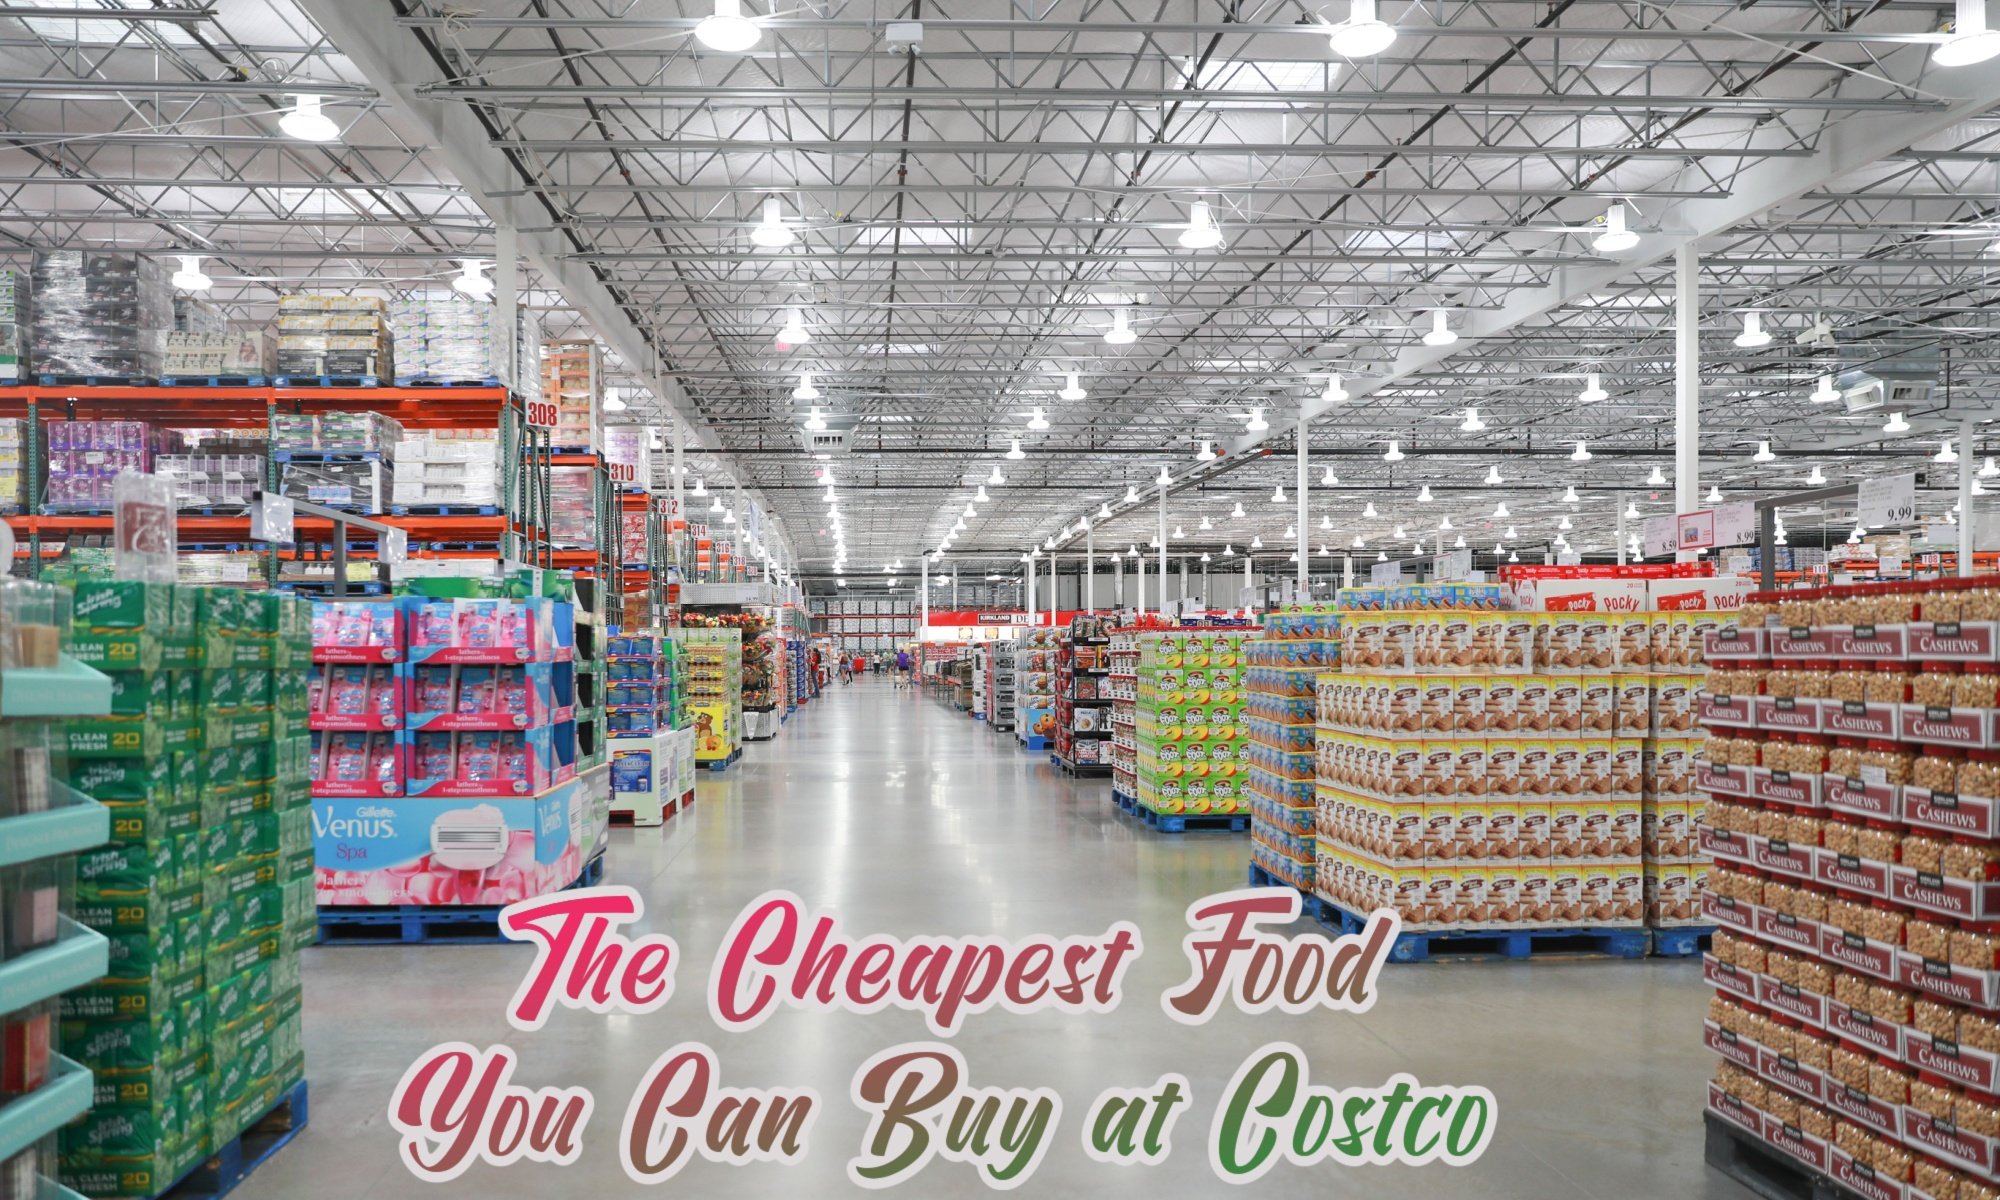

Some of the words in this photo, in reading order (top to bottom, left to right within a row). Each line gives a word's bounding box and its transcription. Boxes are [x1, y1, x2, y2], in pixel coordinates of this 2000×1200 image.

[528, 402, 557, 426] 308
[611, 463, 634, 481] 310
[660, 500, 678, 513] 32
[1888, 506, 1912, 520] 9.99
[691, 525, 706, 536] 314
[1736, 531, 1754, 543] 8.99
[716, 543, 730, 553] 316
[1662, 540, 1677, 552] 8.59
[734, 556, 746, 565] 318
[1923, 555, 1938, 563] 108
[1813, 565, 1826, 573] 110
[86, 588, 114, 604] Irish
[1604, 595, 1640, 611] Pocky
[1680, 597, 1701, 609] Pocky
[77, 595, 122, 615] Spring
[1568, 598, 1591, 611] Pocky
[1016, 615, 1038, 623] DEI
[108, 642, 137, 656] 20
[1712, 640, 1749, 652] CASHEWS
[1780, 640, 1826, 652] CASHEWS
[1842, 639, 1892, 653] CASHEWS
[1920, 636, 1979, 652] CASHEWS
[1706, 705, 1742, 719] CASHEWS
[1766, 710, 1809, 725] CASHEWS
[1832, 715, 1883, 731] CASHEWS
[1913, 720, 1970, 739] CASHEWS
[69, 733, 108, 741] CLEAN
[112, 732, 140, 745] 20
[71, 742, 108, 750] FRESH
[1704, 774, 1740, 789] CASHEWS
[1762, 781, 1804, 800] CASHEWS
[1830, 787, 1881, 810] CASHEWS
[356, 806, 395, 818] Gillette
[1917, 804, 1976, 828] CASHEWS
[115, 819, 143, 832] 20
[312, 805, 395, 838] Venus
[336, 843, 367, 862] Spa
[1705, 837, 1742, 855] CASHEWS
[91, 850, 119, 865] Irish
[1759, 850, 1803, 871] CASHEWS
[82, 857, 128, 878] Spring
[1827, 865, 1876, 889] CASHEWS
[1904, 884, 1962, 910] CASHEWS
[117, 907, 144, 919] 20
[1708, 902, 1746, 925] CASHEWS
[1766, 920, 1810, 944] CASHEWS
[1832, 942, 1881, 970] CASHEWS
[1711, 967, 1748, 993] CASHEWS
[1911, 971, 1971, 1000] CASHEWS
[75, 996, 113, 1006] CLEAN
[119, 995, 146, 1008] 20
[1769, 989, 1812, 1016] CASHEWS
[77, 1005, 113, 1015] FRESH
[95, 1028, 123, 1044] Irish
[1837, 1015, 1888, 1047] CASHEWS
[86, 1034, 131, 1057] Spring
[1711, 1035, 1750, 1063] CASHEWS
[1918, 1048, 1980, 1082] CASHEWS
[1768, 1063, 1813, 1093] CASHEWS
[94, 1085, 116, 1095] EAN
[120, 1083, 148, 1097] 20
[94, 1094, 116, 1103] ESH
[1716, 1098, 1755, 1128] CASHEWS
[1835, 1092, 1887, 1126] CASHEWS
[98, 1115, 126, 1132] Irish
[89, 1122, 133, 1144] Spring
[1772, 1131, 1817, 1163] CASHEWS
[1917, 1124, 1977, 1160] CASHEWS
[80, 1173, 117, 1183] CLEAN
[122, 1172, 149, 1185] 20
[1840, 1164, 1891, 1200] CASHEWS
